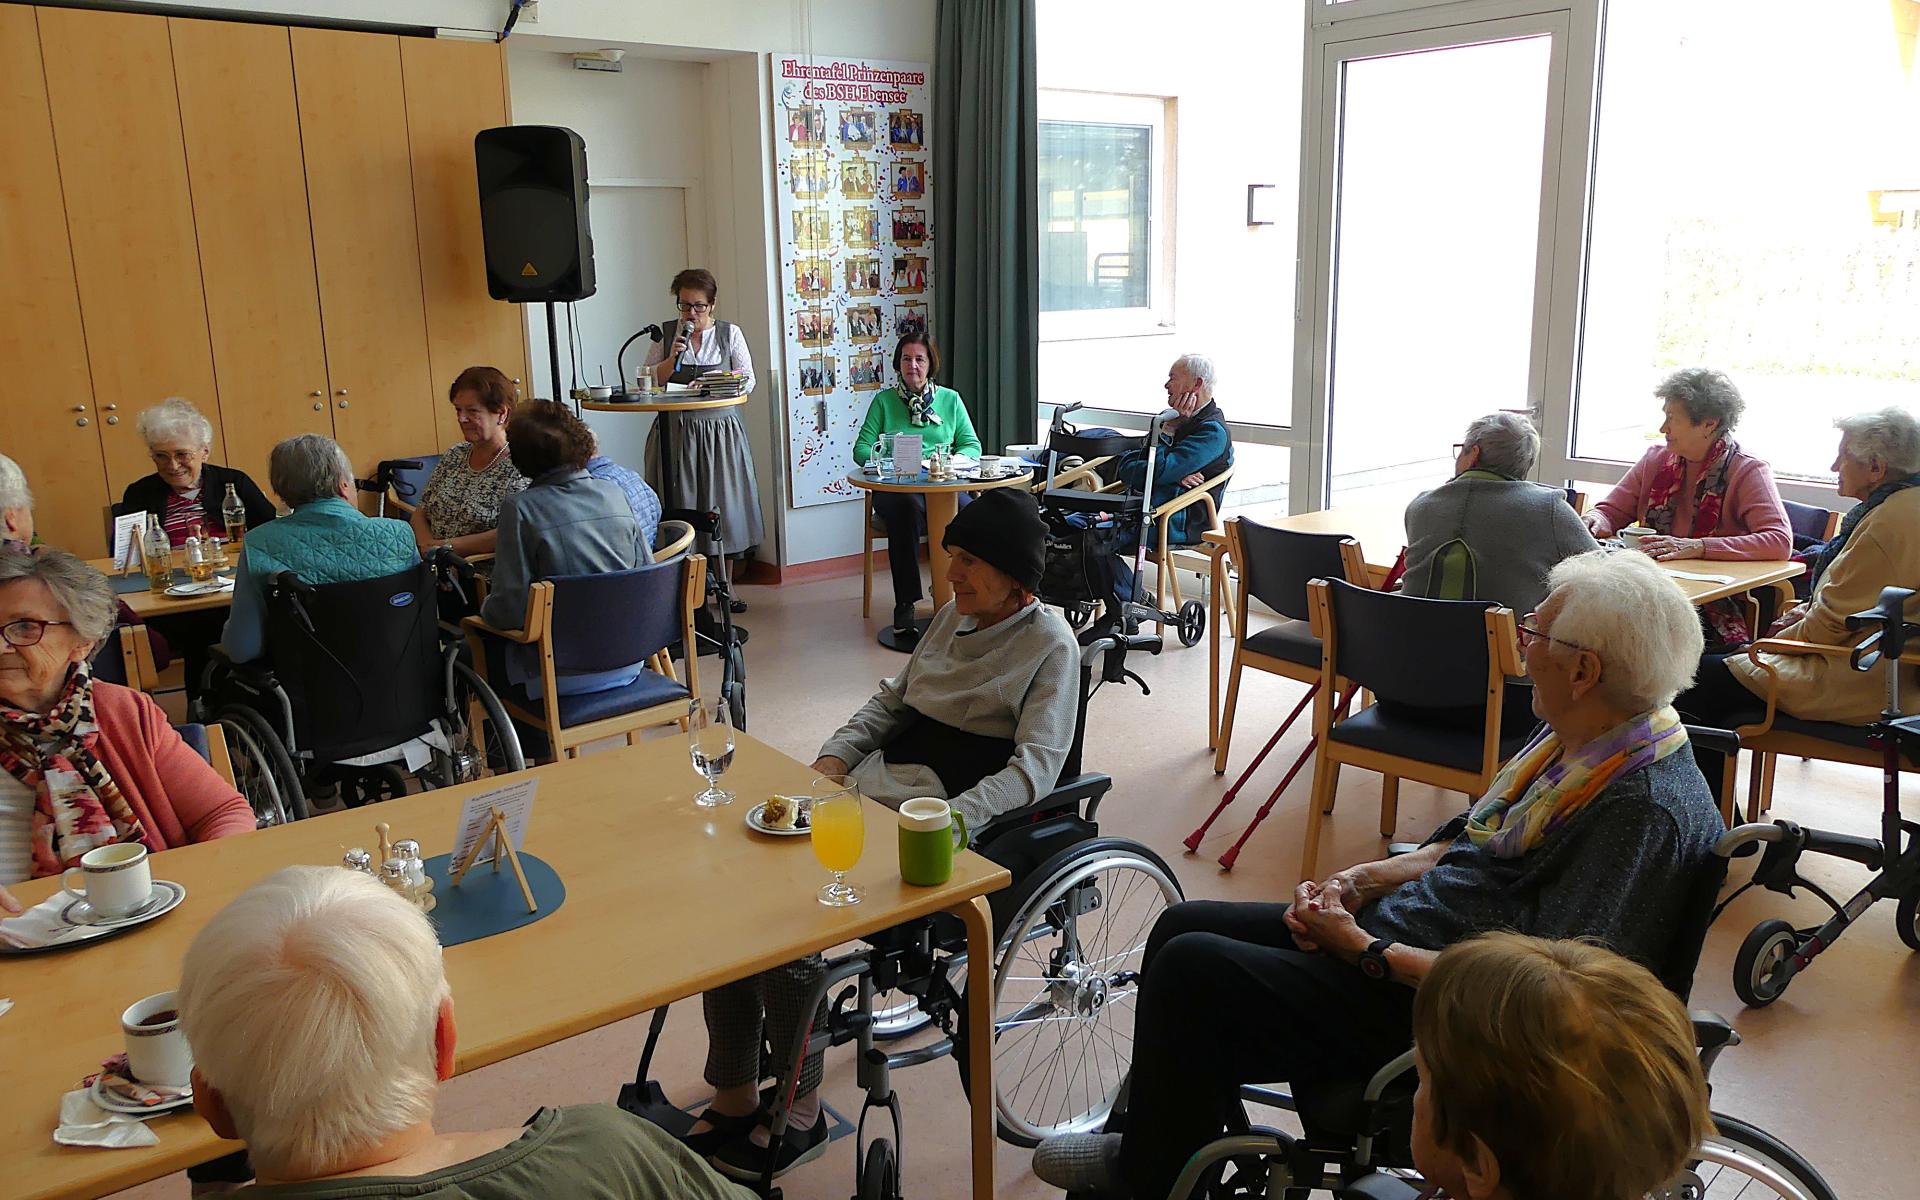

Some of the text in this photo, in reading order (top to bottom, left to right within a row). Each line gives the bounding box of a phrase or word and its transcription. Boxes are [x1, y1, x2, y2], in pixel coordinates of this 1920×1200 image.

[782, 60, 925, 87] Ehrentafel Prinzenpaare
[804, 82, 907, 103] des BSH Ebensee
